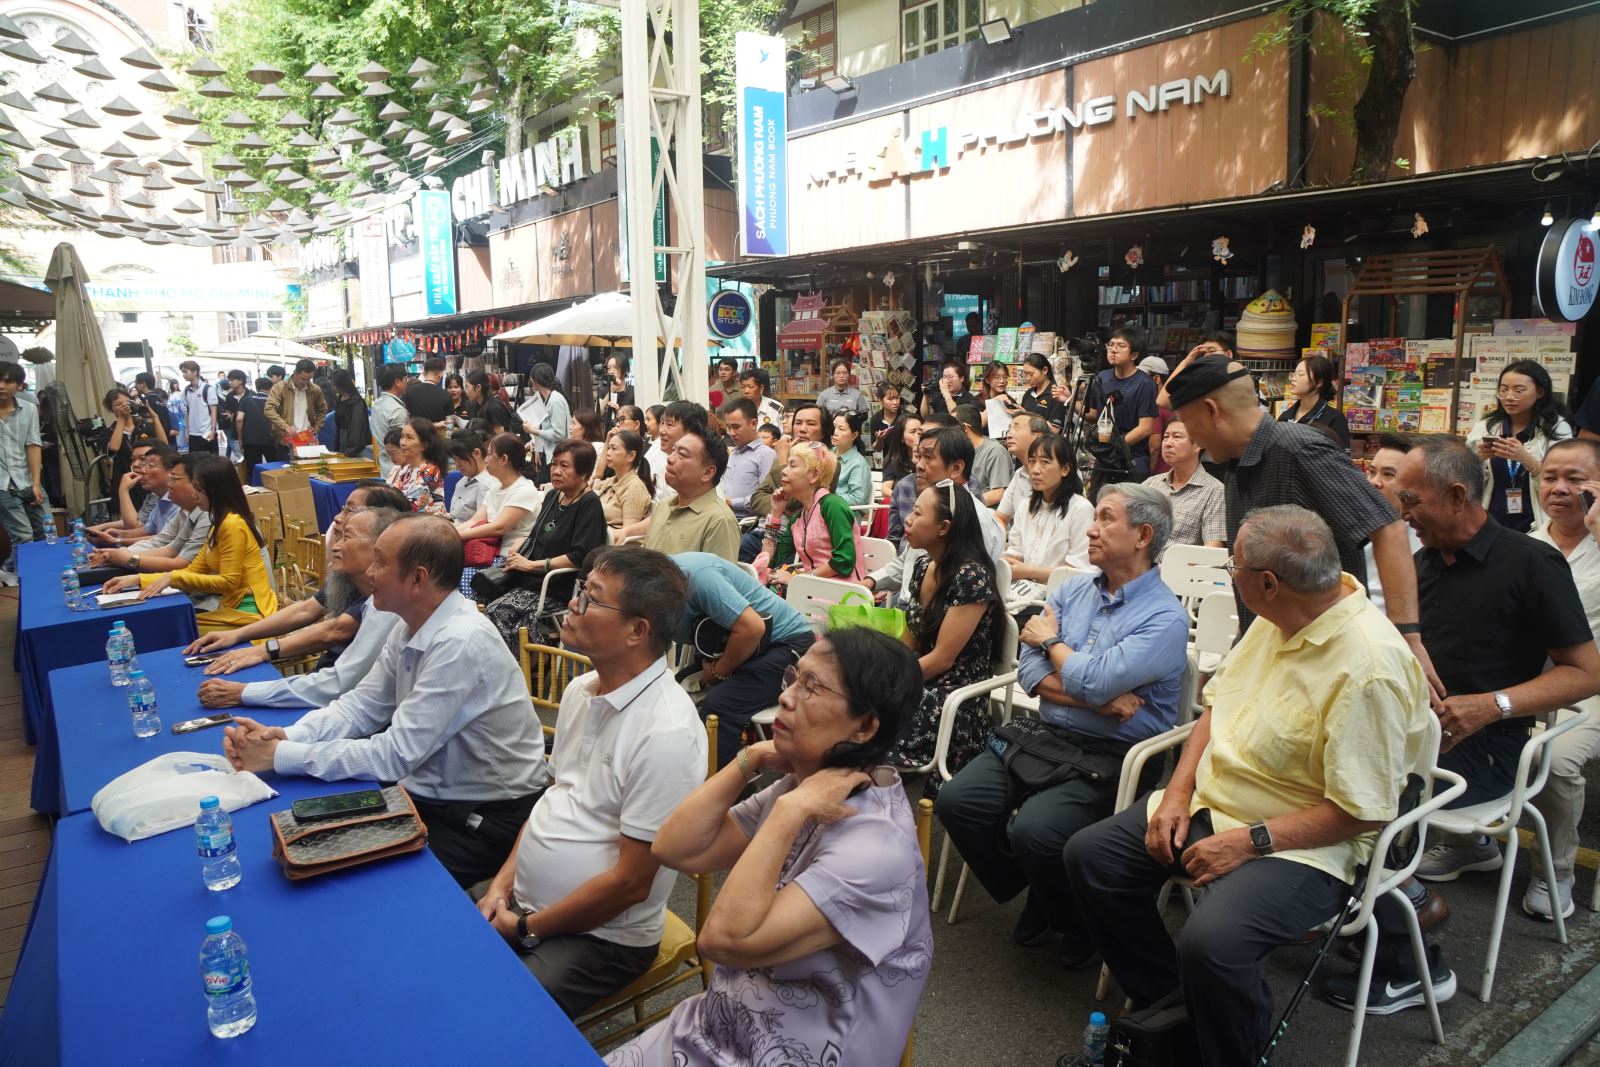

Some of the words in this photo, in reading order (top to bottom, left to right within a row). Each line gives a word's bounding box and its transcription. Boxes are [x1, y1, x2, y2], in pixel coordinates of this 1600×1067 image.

[1127, 68, 1231, 118] NAM
[753, 106, 764, 138] NAM
[767, 119, 776, 150] BOOK
[499, 126, 590, 207] MINH
[753, 141, 765, 198] PHƯƠNG
[767, 153, 776, 179] NAM
[753, 201, 766, 240] SÁCH
[717, 317, 745, 326] STORE
[718, 307, 745, 320] BOOK
